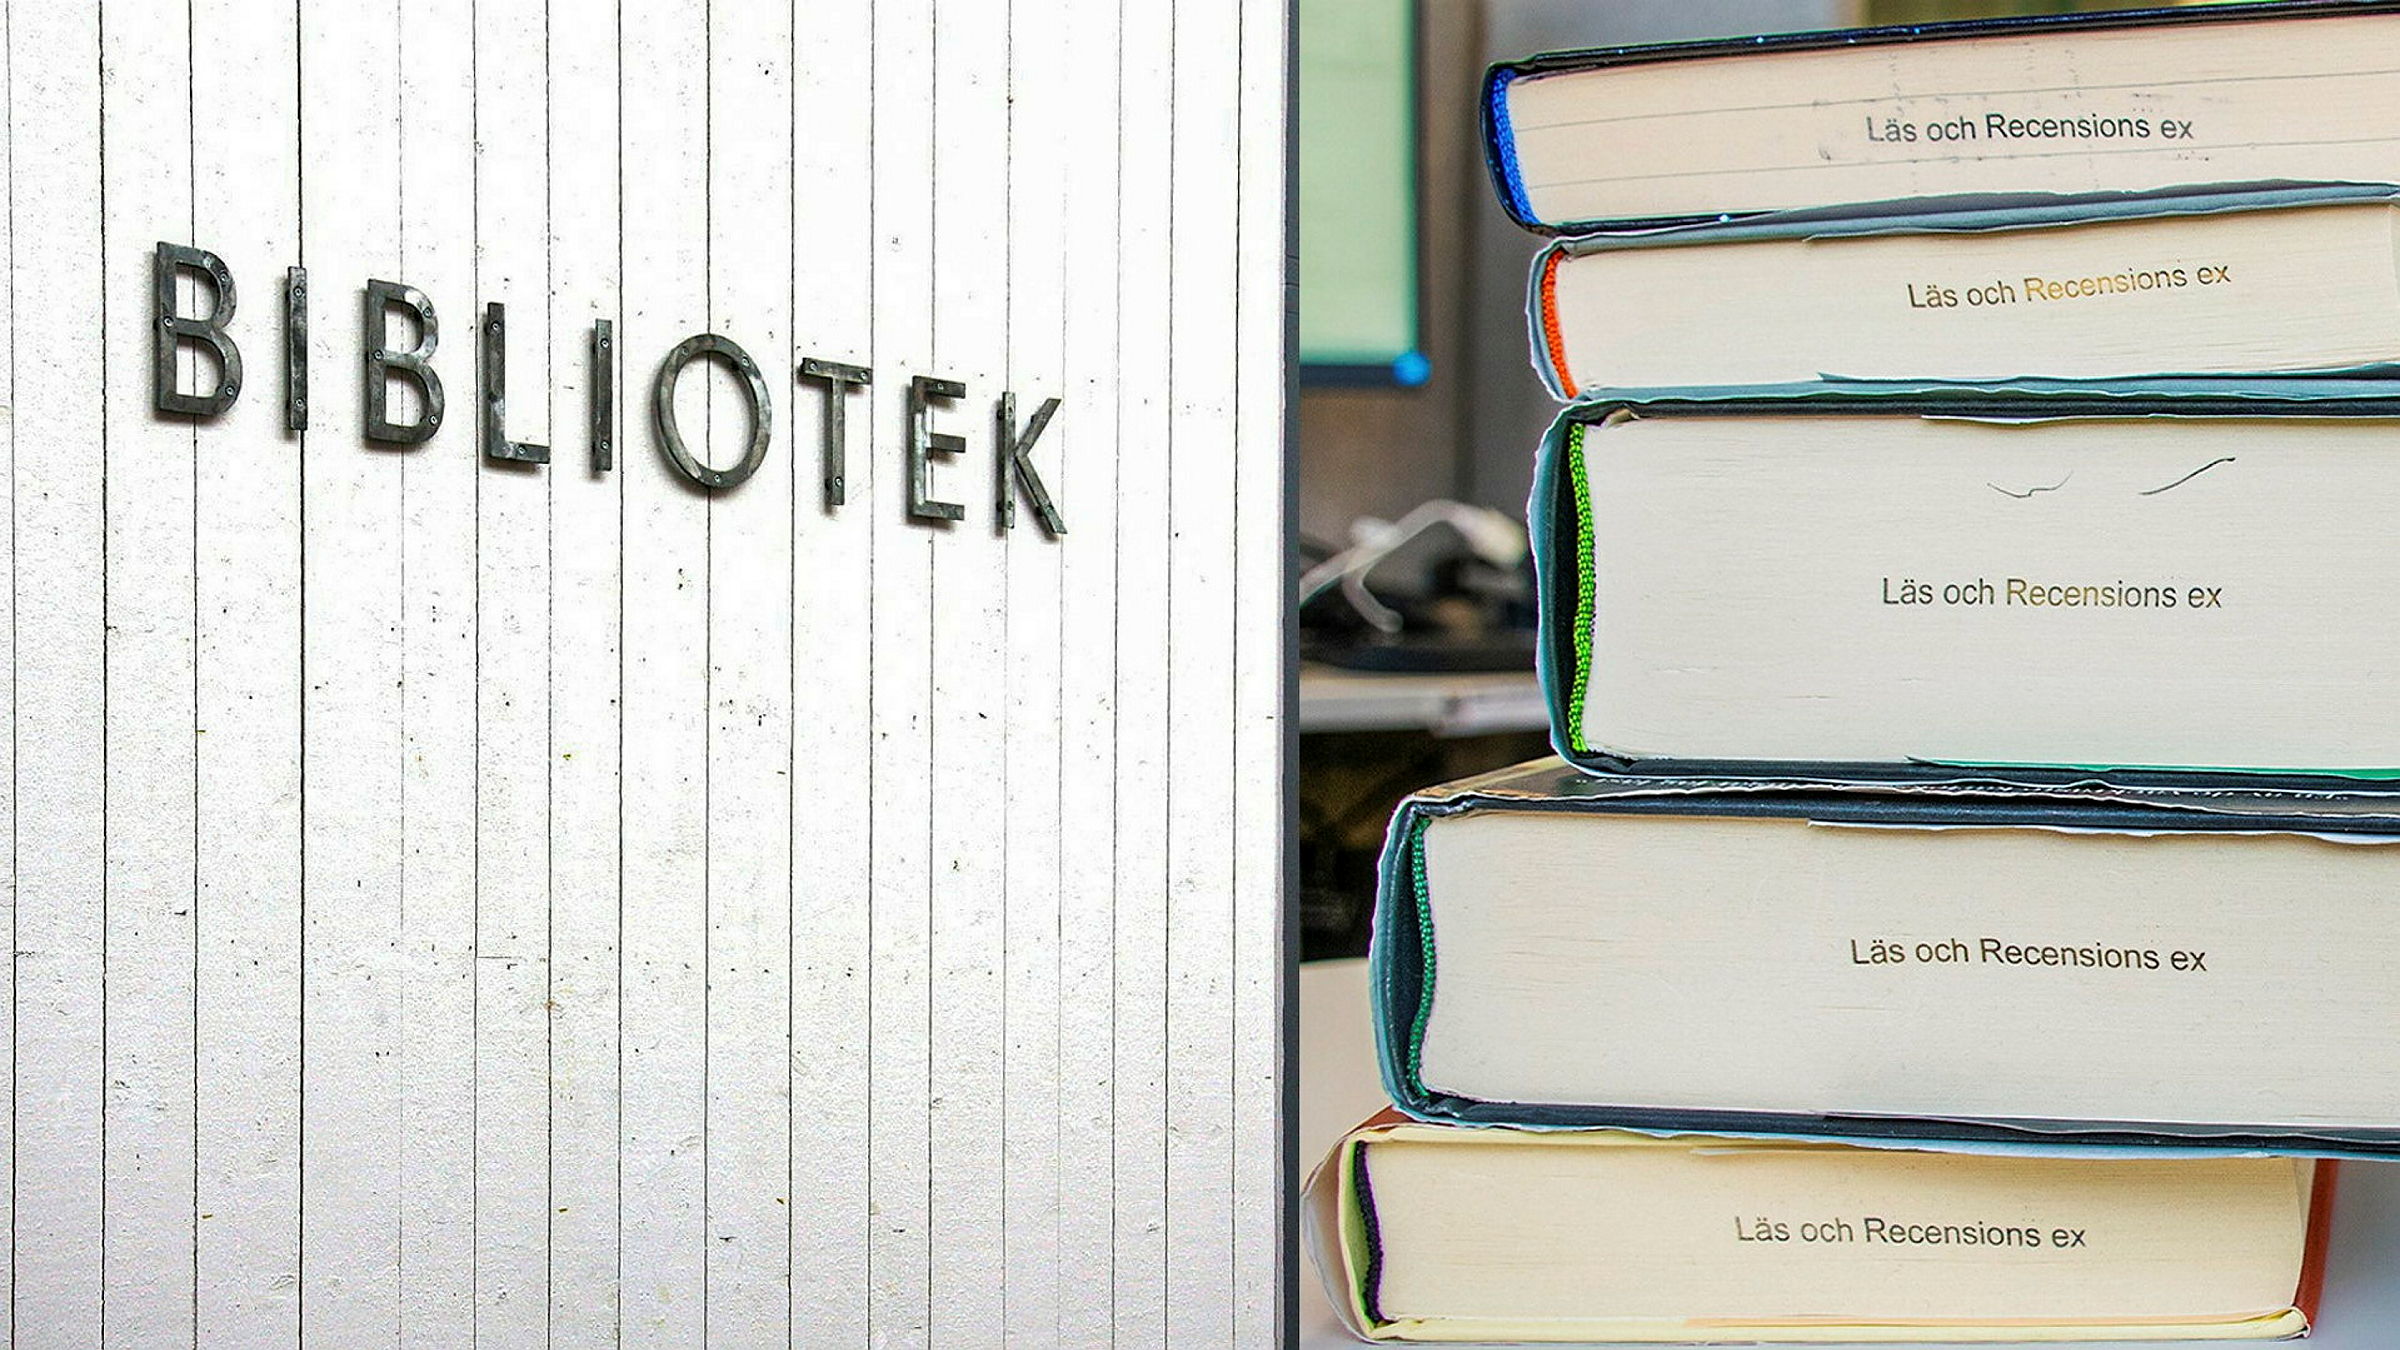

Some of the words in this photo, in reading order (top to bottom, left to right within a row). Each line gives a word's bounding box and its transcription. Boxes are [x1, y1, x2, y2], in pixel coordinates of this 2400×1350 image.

[1866, 116, 1918, 143] Läs
[1926, 115, 1977, 142] och
[1985, 112, 2151, 139] Recensions
[2160, 119, 2194, 140] ex
[1907, 283, 1959, 309] Läs
[1966, 279, 2016, 307] och
[2023, 267, 2188, 303] Recensions
[2197, 265, 2232, 287] ex
[152, 240, 1067, 536] BIBLIOTEK
[1882, 577, 1934, 605] Läs
[1943, 577, 1995, 606] och
[2006, 577, 2177, 609] Recensions
[2187, 586, 2223, 609] ex
[1850, 938, 1906, 965] Läs
[1915, 937, 1970, 963] och
[1979, 937, 2160, 971] Recensions
[2169, 950, 2208, 972] ex
[1735, 1216, 1791, 1242] Läs
[1800, 1216, 1854, 1243] och
[1863, 1217, 2042, 1248] Recensions
[2051, 1228, 2086, 1248] ex
